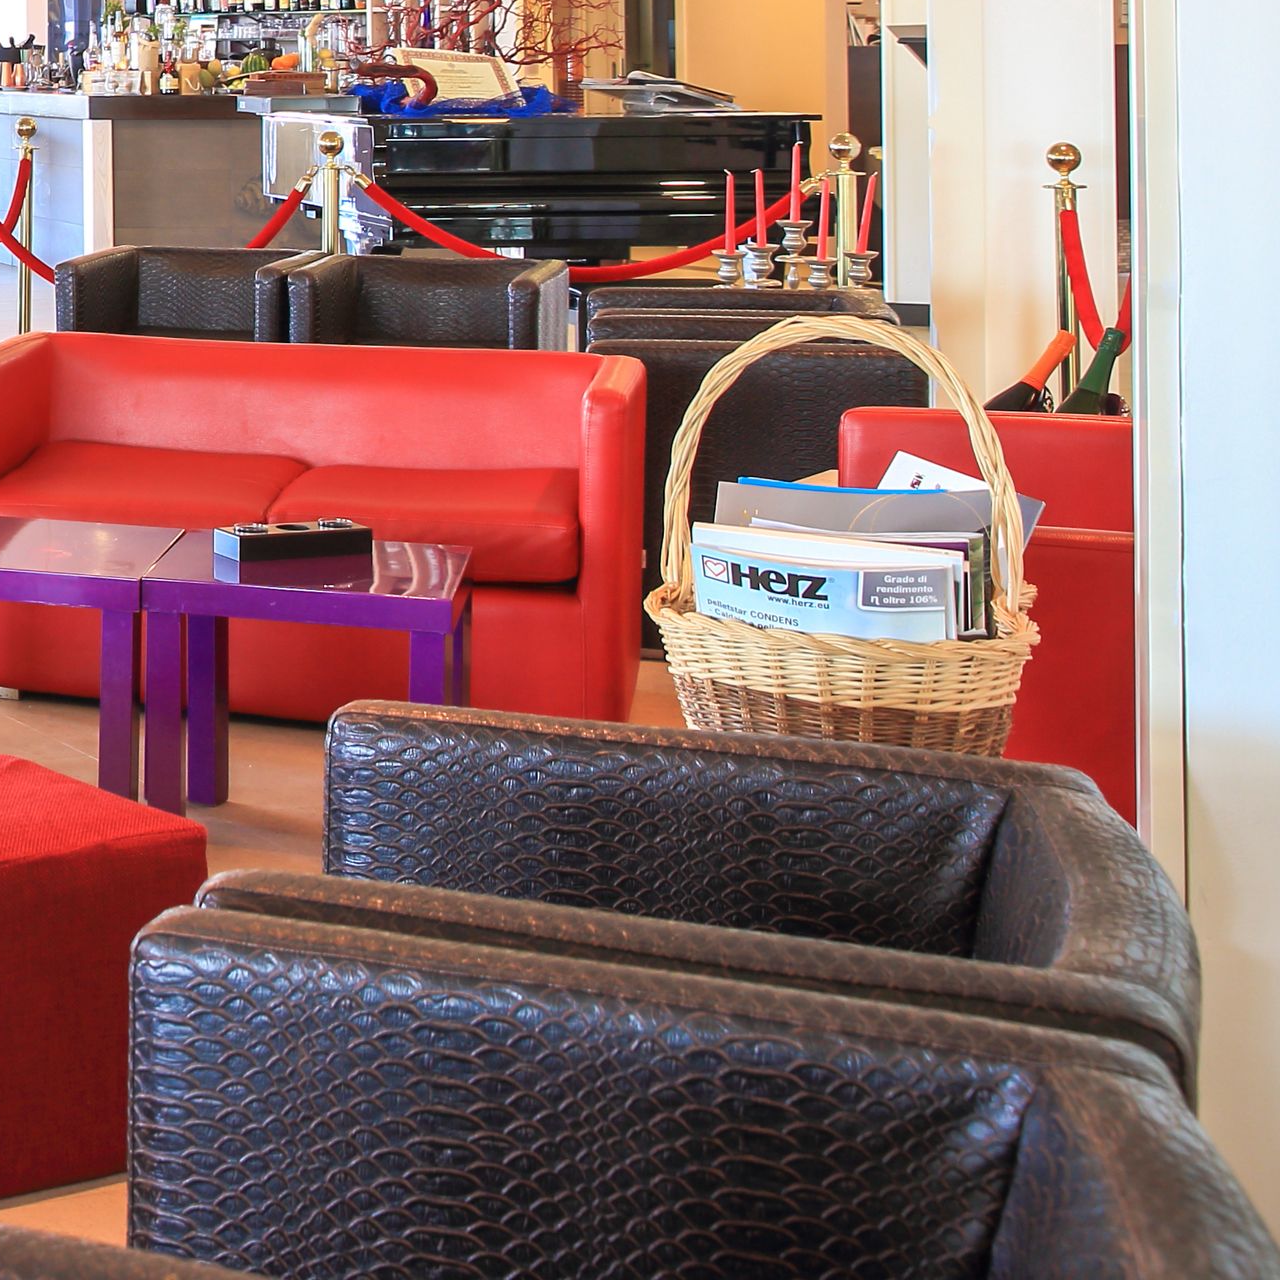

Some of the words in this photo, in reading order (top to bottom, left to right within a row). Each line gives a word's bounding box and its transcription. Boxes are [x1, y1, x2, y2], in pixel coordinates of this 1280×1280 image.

[884, 575, 915, 583] Grado
[917, 575, 927, 583] di
[876, 585, 933, 593] rendimento
[767, 595, 829, 609] www.herz.eu
[883, 596, 906, 604] oltre
[910, 595, 938, 603] 106%
[750, 610, 799, 627] CONDENS
